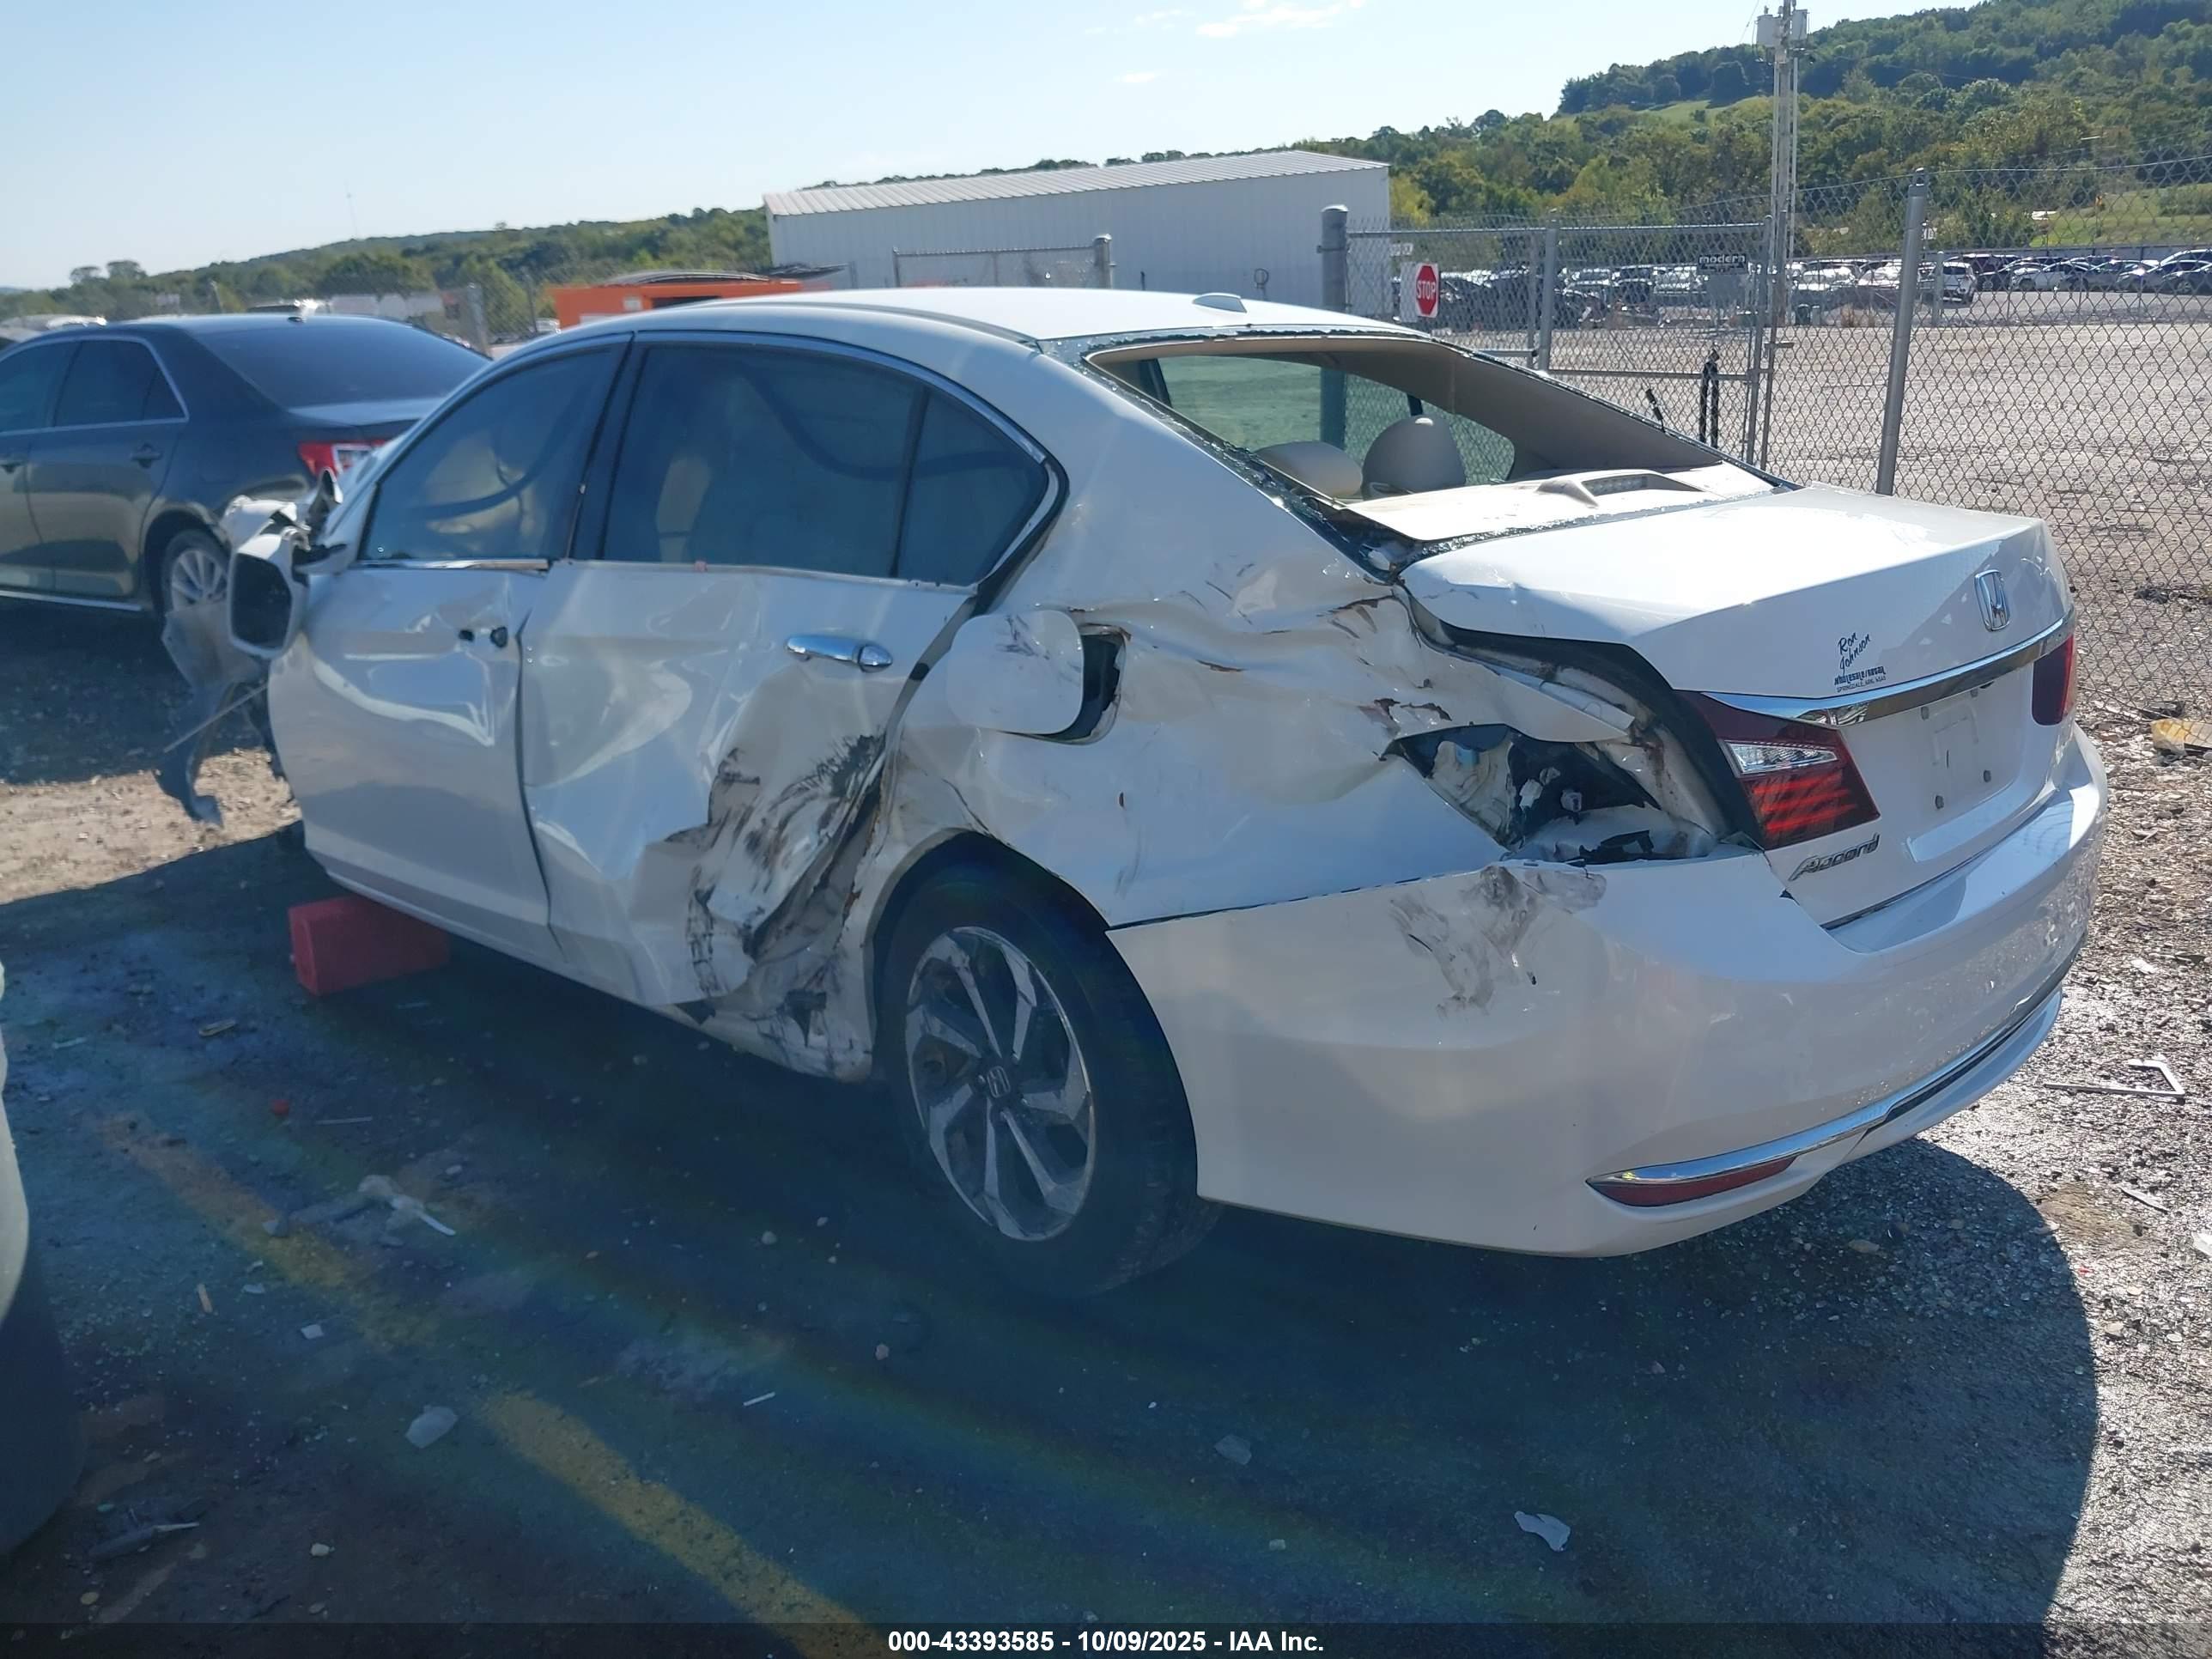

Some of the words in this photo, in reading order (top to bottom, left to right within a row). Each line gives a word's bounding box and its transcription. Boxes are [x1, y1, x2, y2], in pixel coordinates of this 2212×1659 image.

[1699, 253, 1746, 264] modern
[1417, 280, 1437, 300] STOP
[1838, 632, 1857, 656] Ron
[1839, 634, 1871, 677] Johnson
[1788, 832, 1881, 882] Accord
